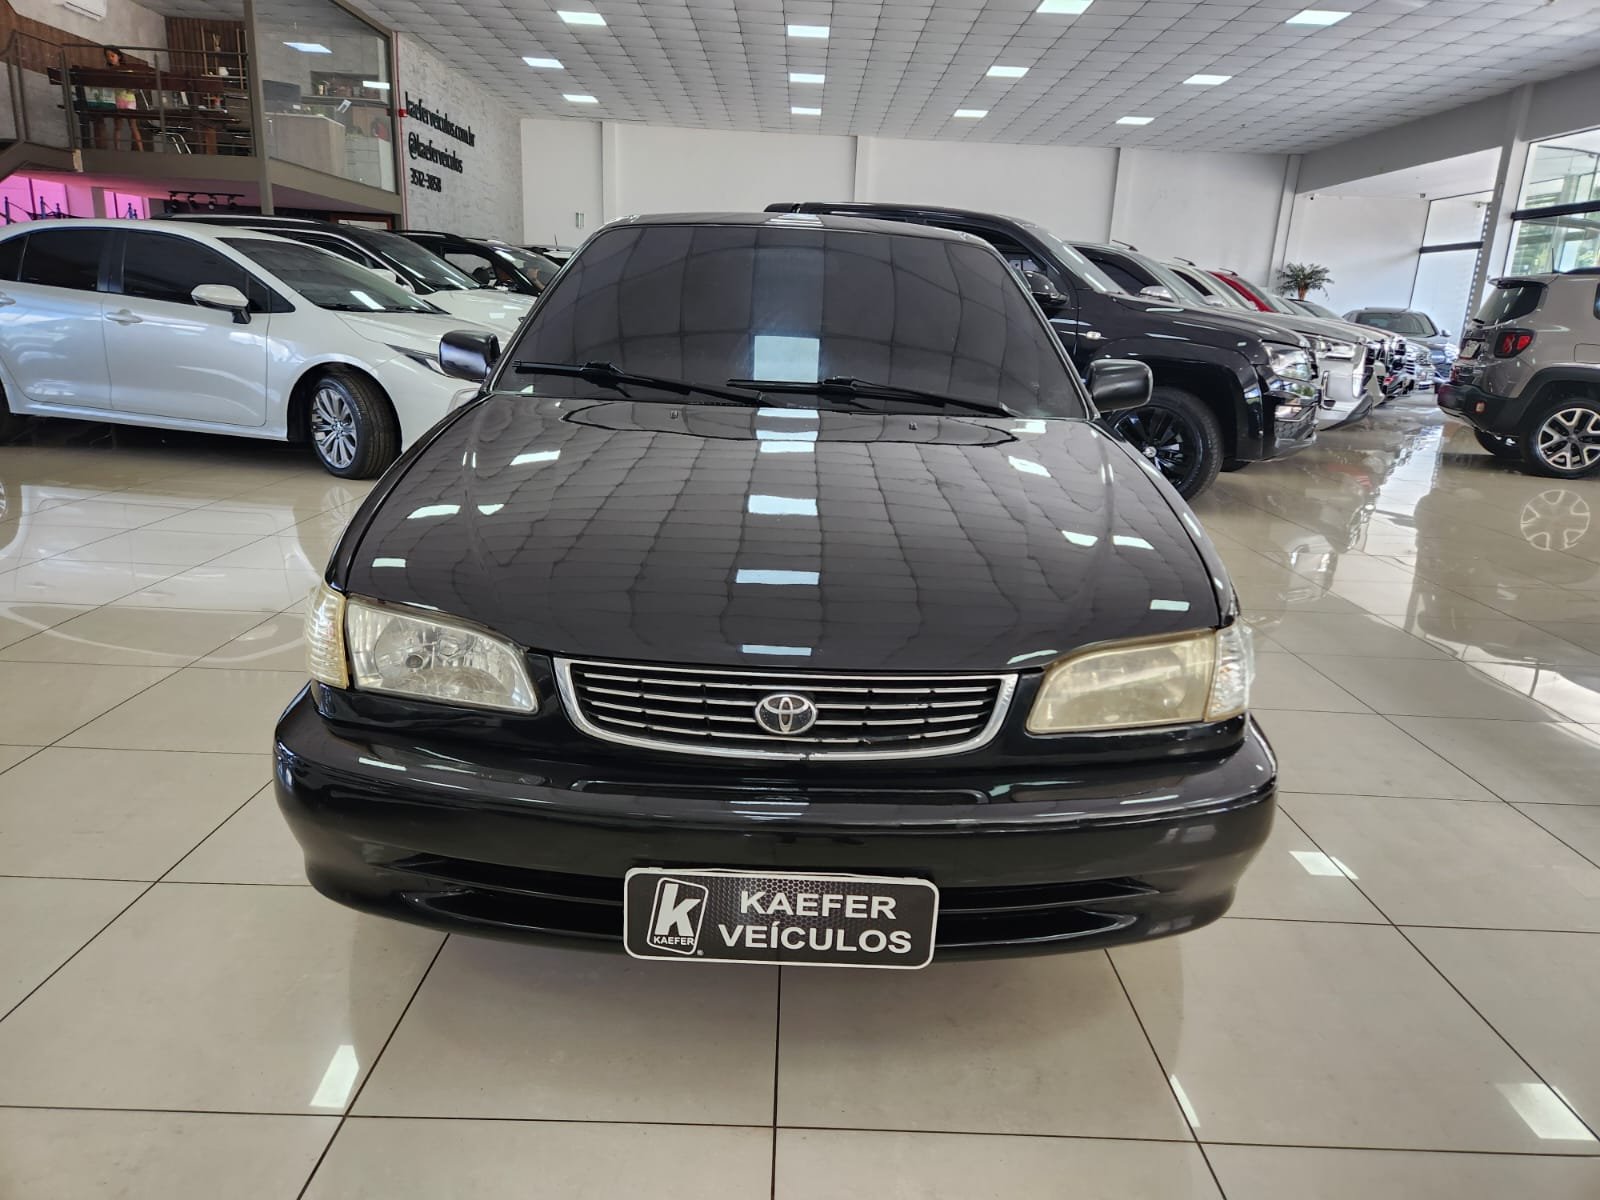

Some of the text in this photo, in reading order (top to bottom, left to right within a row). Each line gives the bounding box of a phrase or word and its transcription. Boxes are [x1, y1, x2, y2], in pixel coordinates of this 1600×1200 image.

[408, 131, 463, 174] @kaeferveiculos
[740, 890, 897, 920] KAEFER
[653, 935, 695, 947] KAEFER
[718, 921, 912, 954] VEÍCULOS
